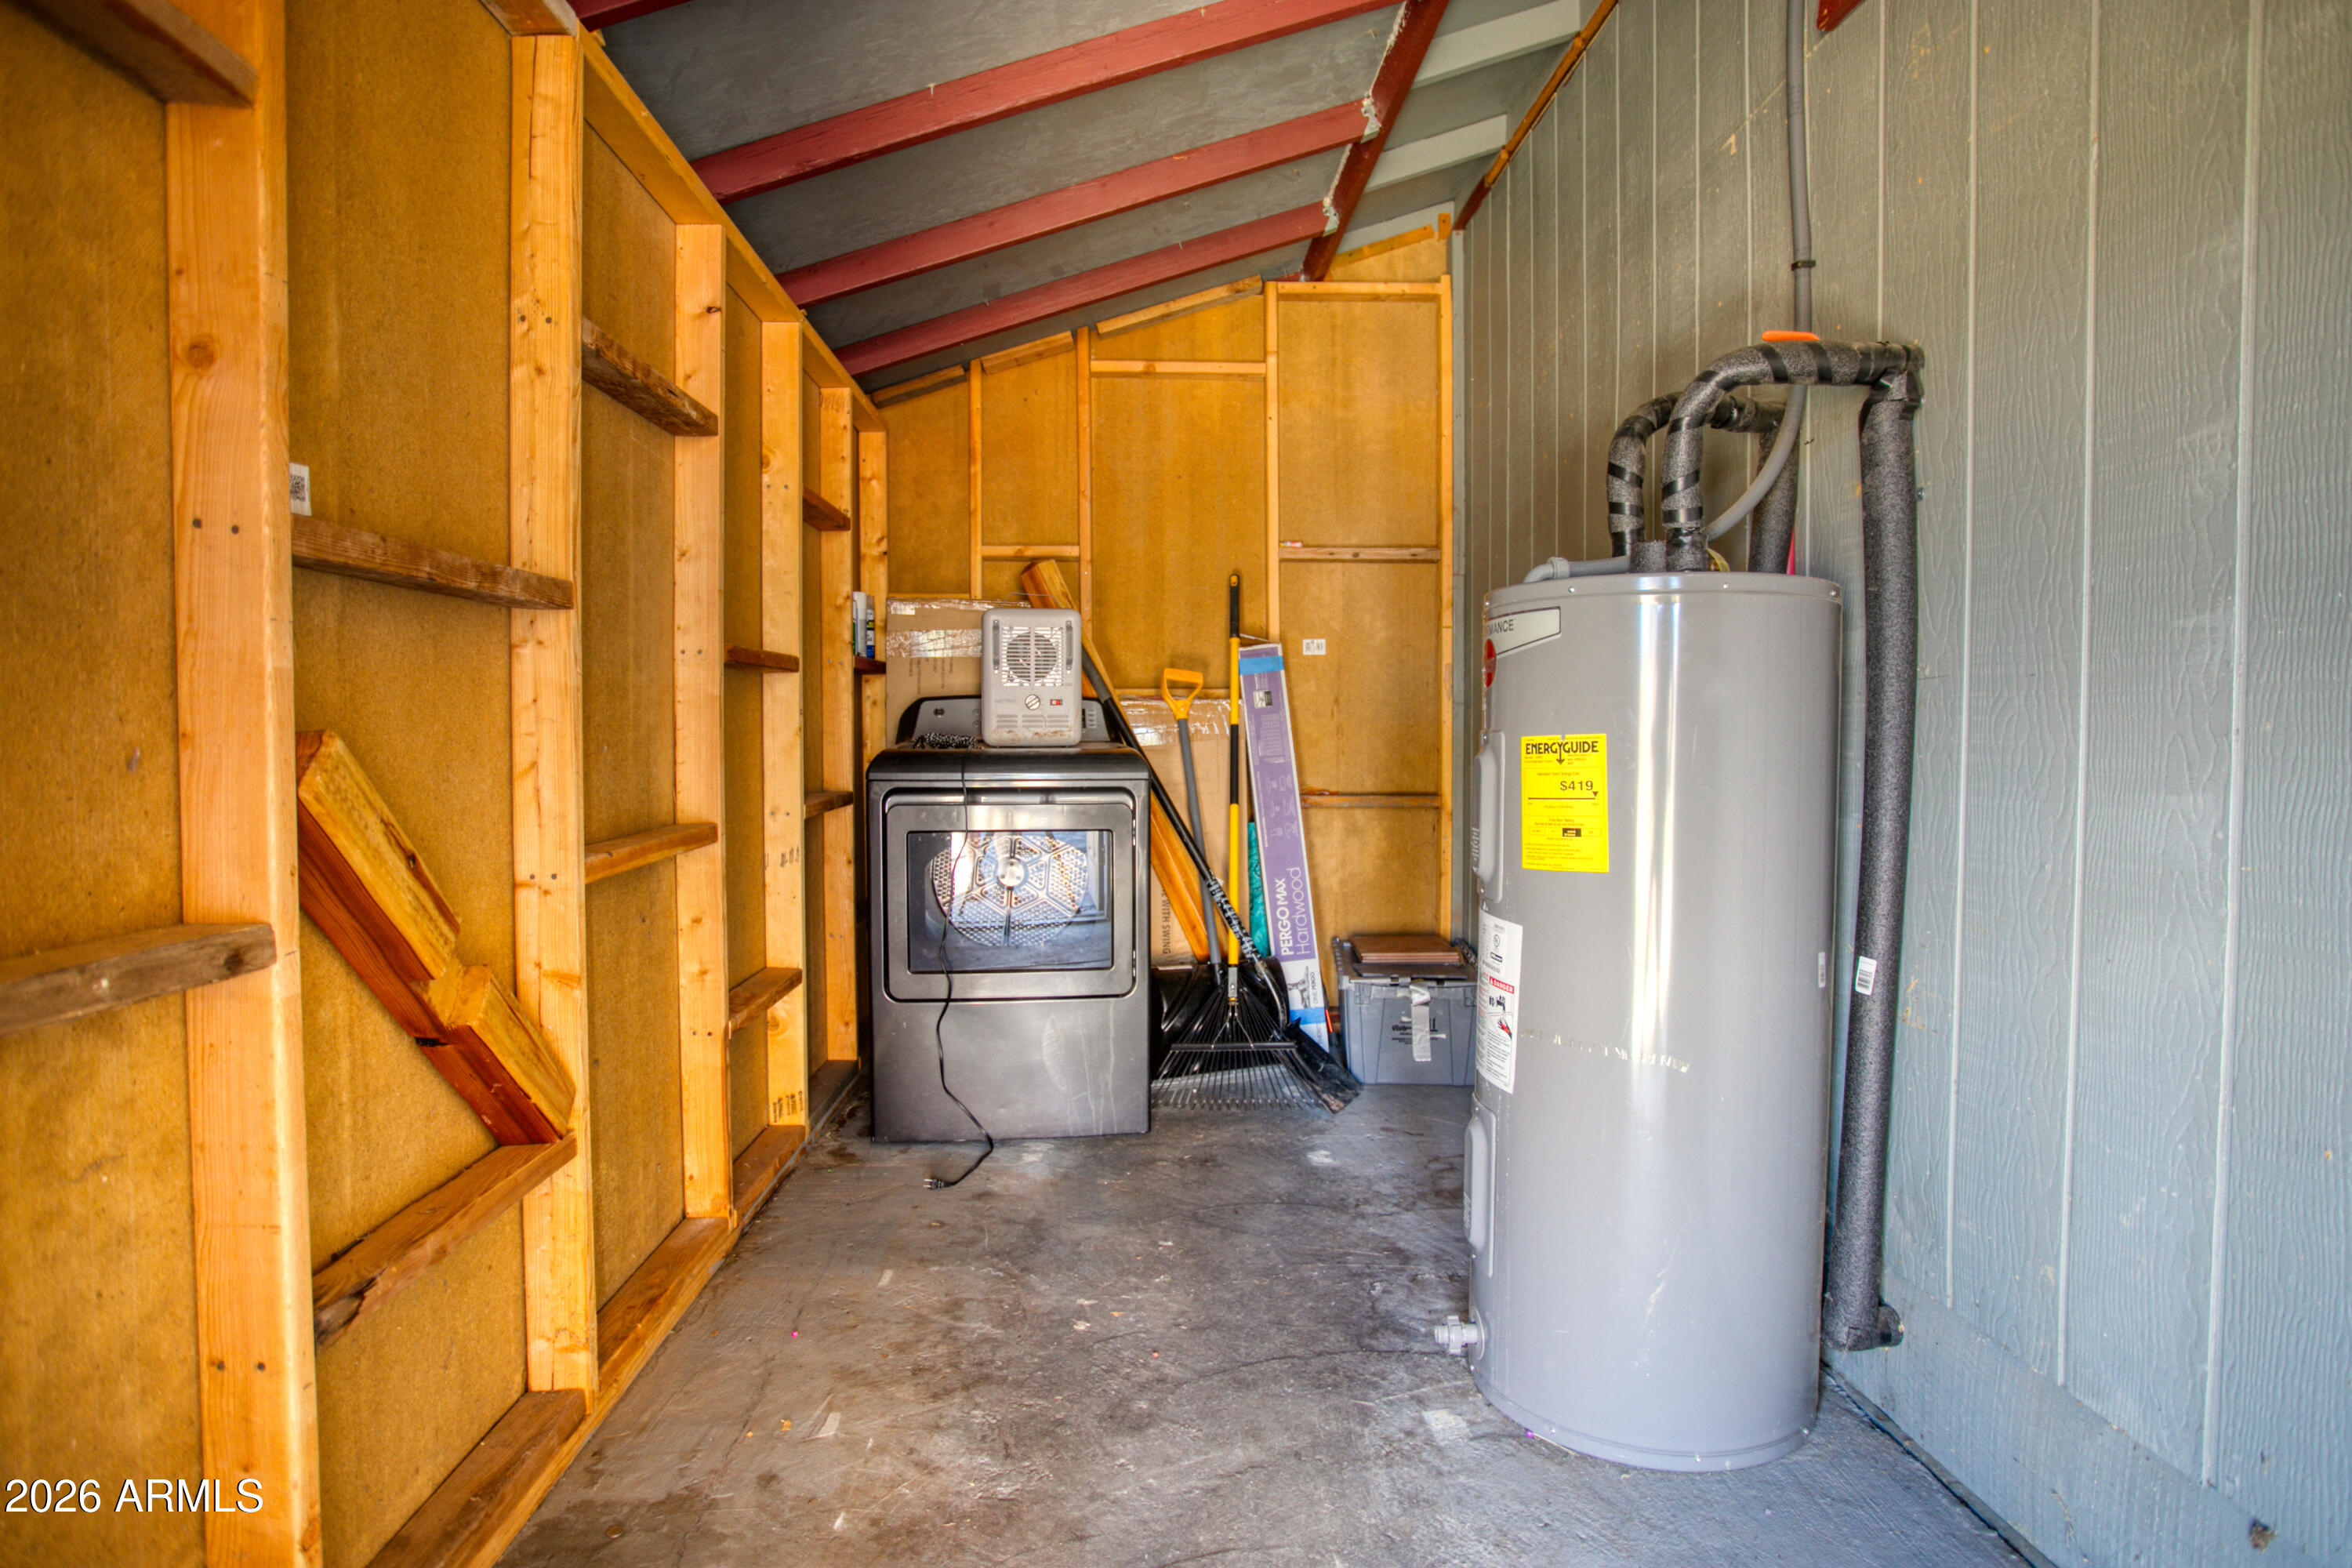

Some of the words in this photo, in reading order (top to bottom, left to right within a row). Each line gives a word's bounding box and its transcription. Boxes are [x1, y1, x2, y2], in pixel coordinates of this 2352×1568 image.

[1559, 780, 1594, 791] $419
[1275, 877, 1288, 906] MAX
[1162, 899, 1171, 923] WITH
[1287, 867, 1310, 955] Hardwood
[1162, 924, 1171, 954] SWING
[1276, 906, 1294, 956] PERGO
[1494, 979, 1513, 993] DANGER
